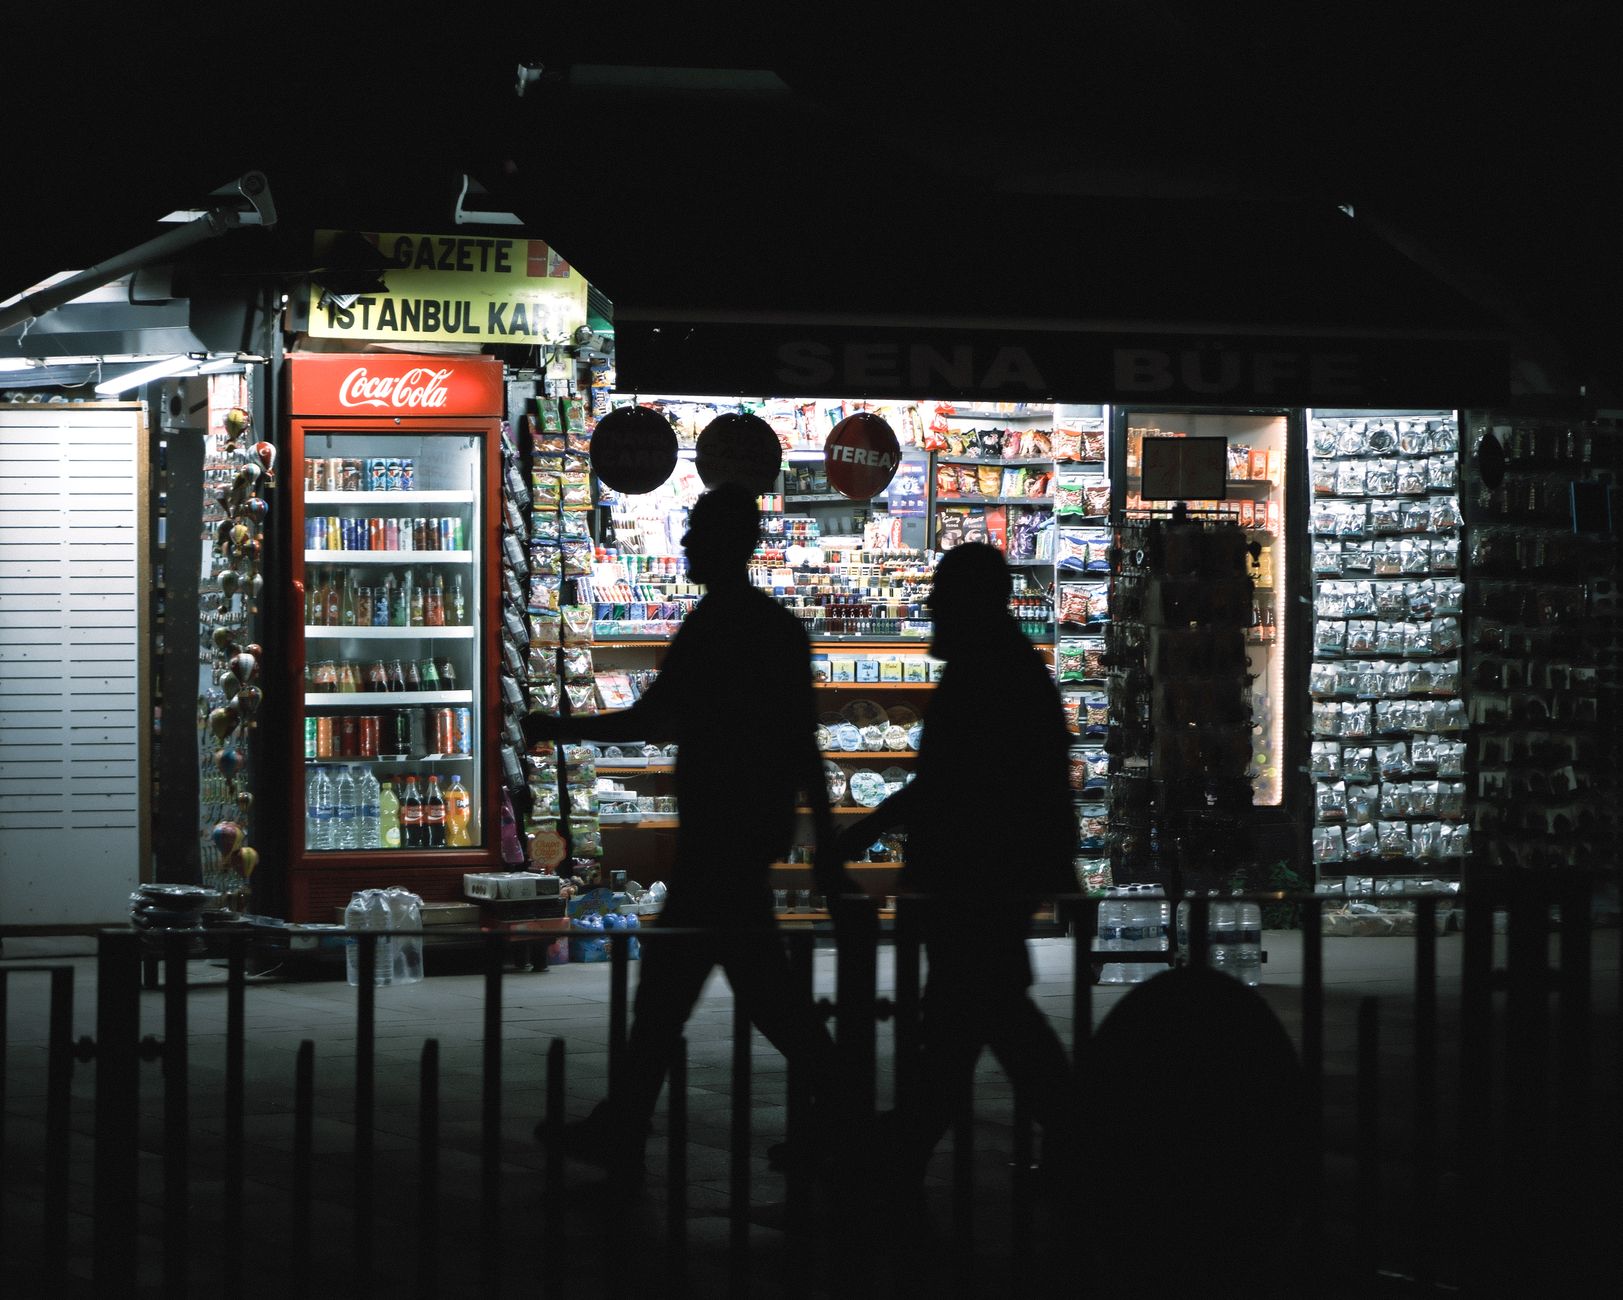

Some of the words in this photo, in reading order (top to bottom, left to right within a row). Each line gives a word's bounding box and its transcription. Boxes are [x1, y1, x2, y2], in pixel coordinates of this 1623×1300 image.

[394, 236, 512, 272] GAZETE
[488, 301, 570, 336] KAR
[776, 340, 1048, 390] SENA
[1113, 340, 1363, 394] BÜFE
[339, 367, 454, 407] Coca-Cola
[830, 444, 892, 469] TEREA
